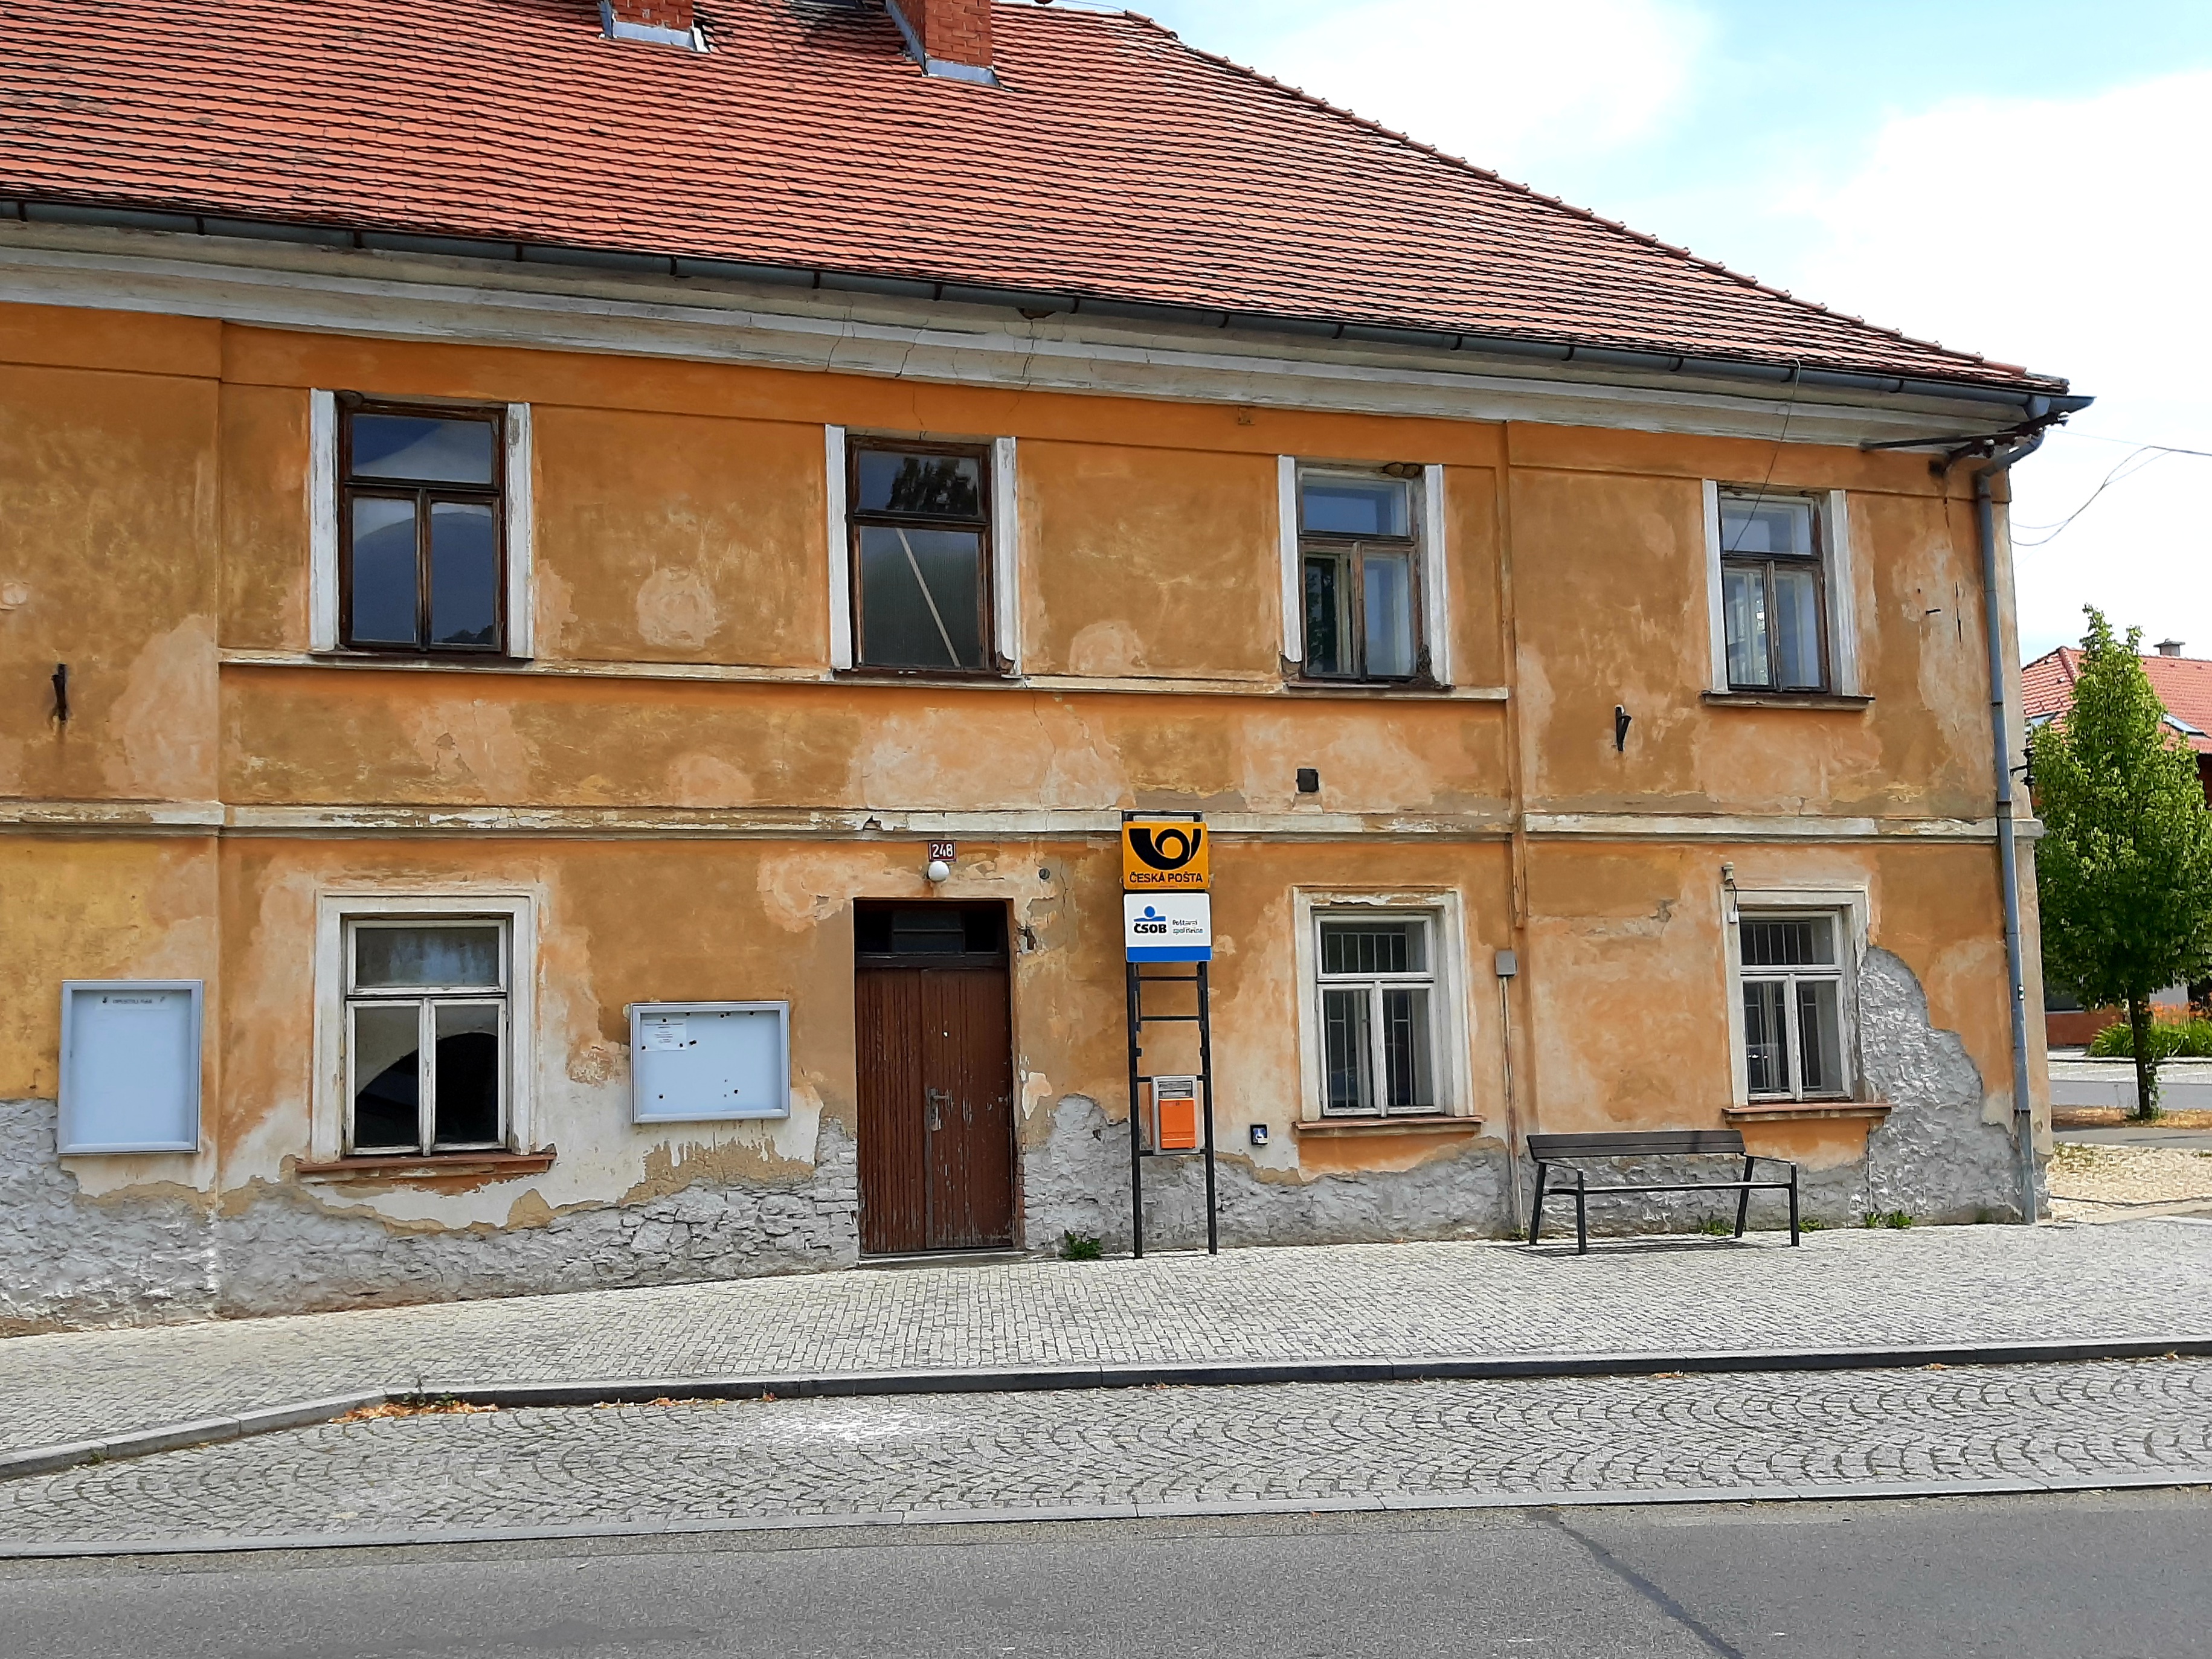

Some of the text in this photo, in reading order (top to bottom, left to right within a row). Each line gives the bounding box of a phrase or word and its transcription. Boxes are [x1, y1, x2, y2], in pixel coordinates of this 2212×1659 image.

[932, 844, 953, 858] 248
[1129, 871, 1203, 883] ČESKÁ POŠTA
[1134, 923, 1167, 934] ČSOB
